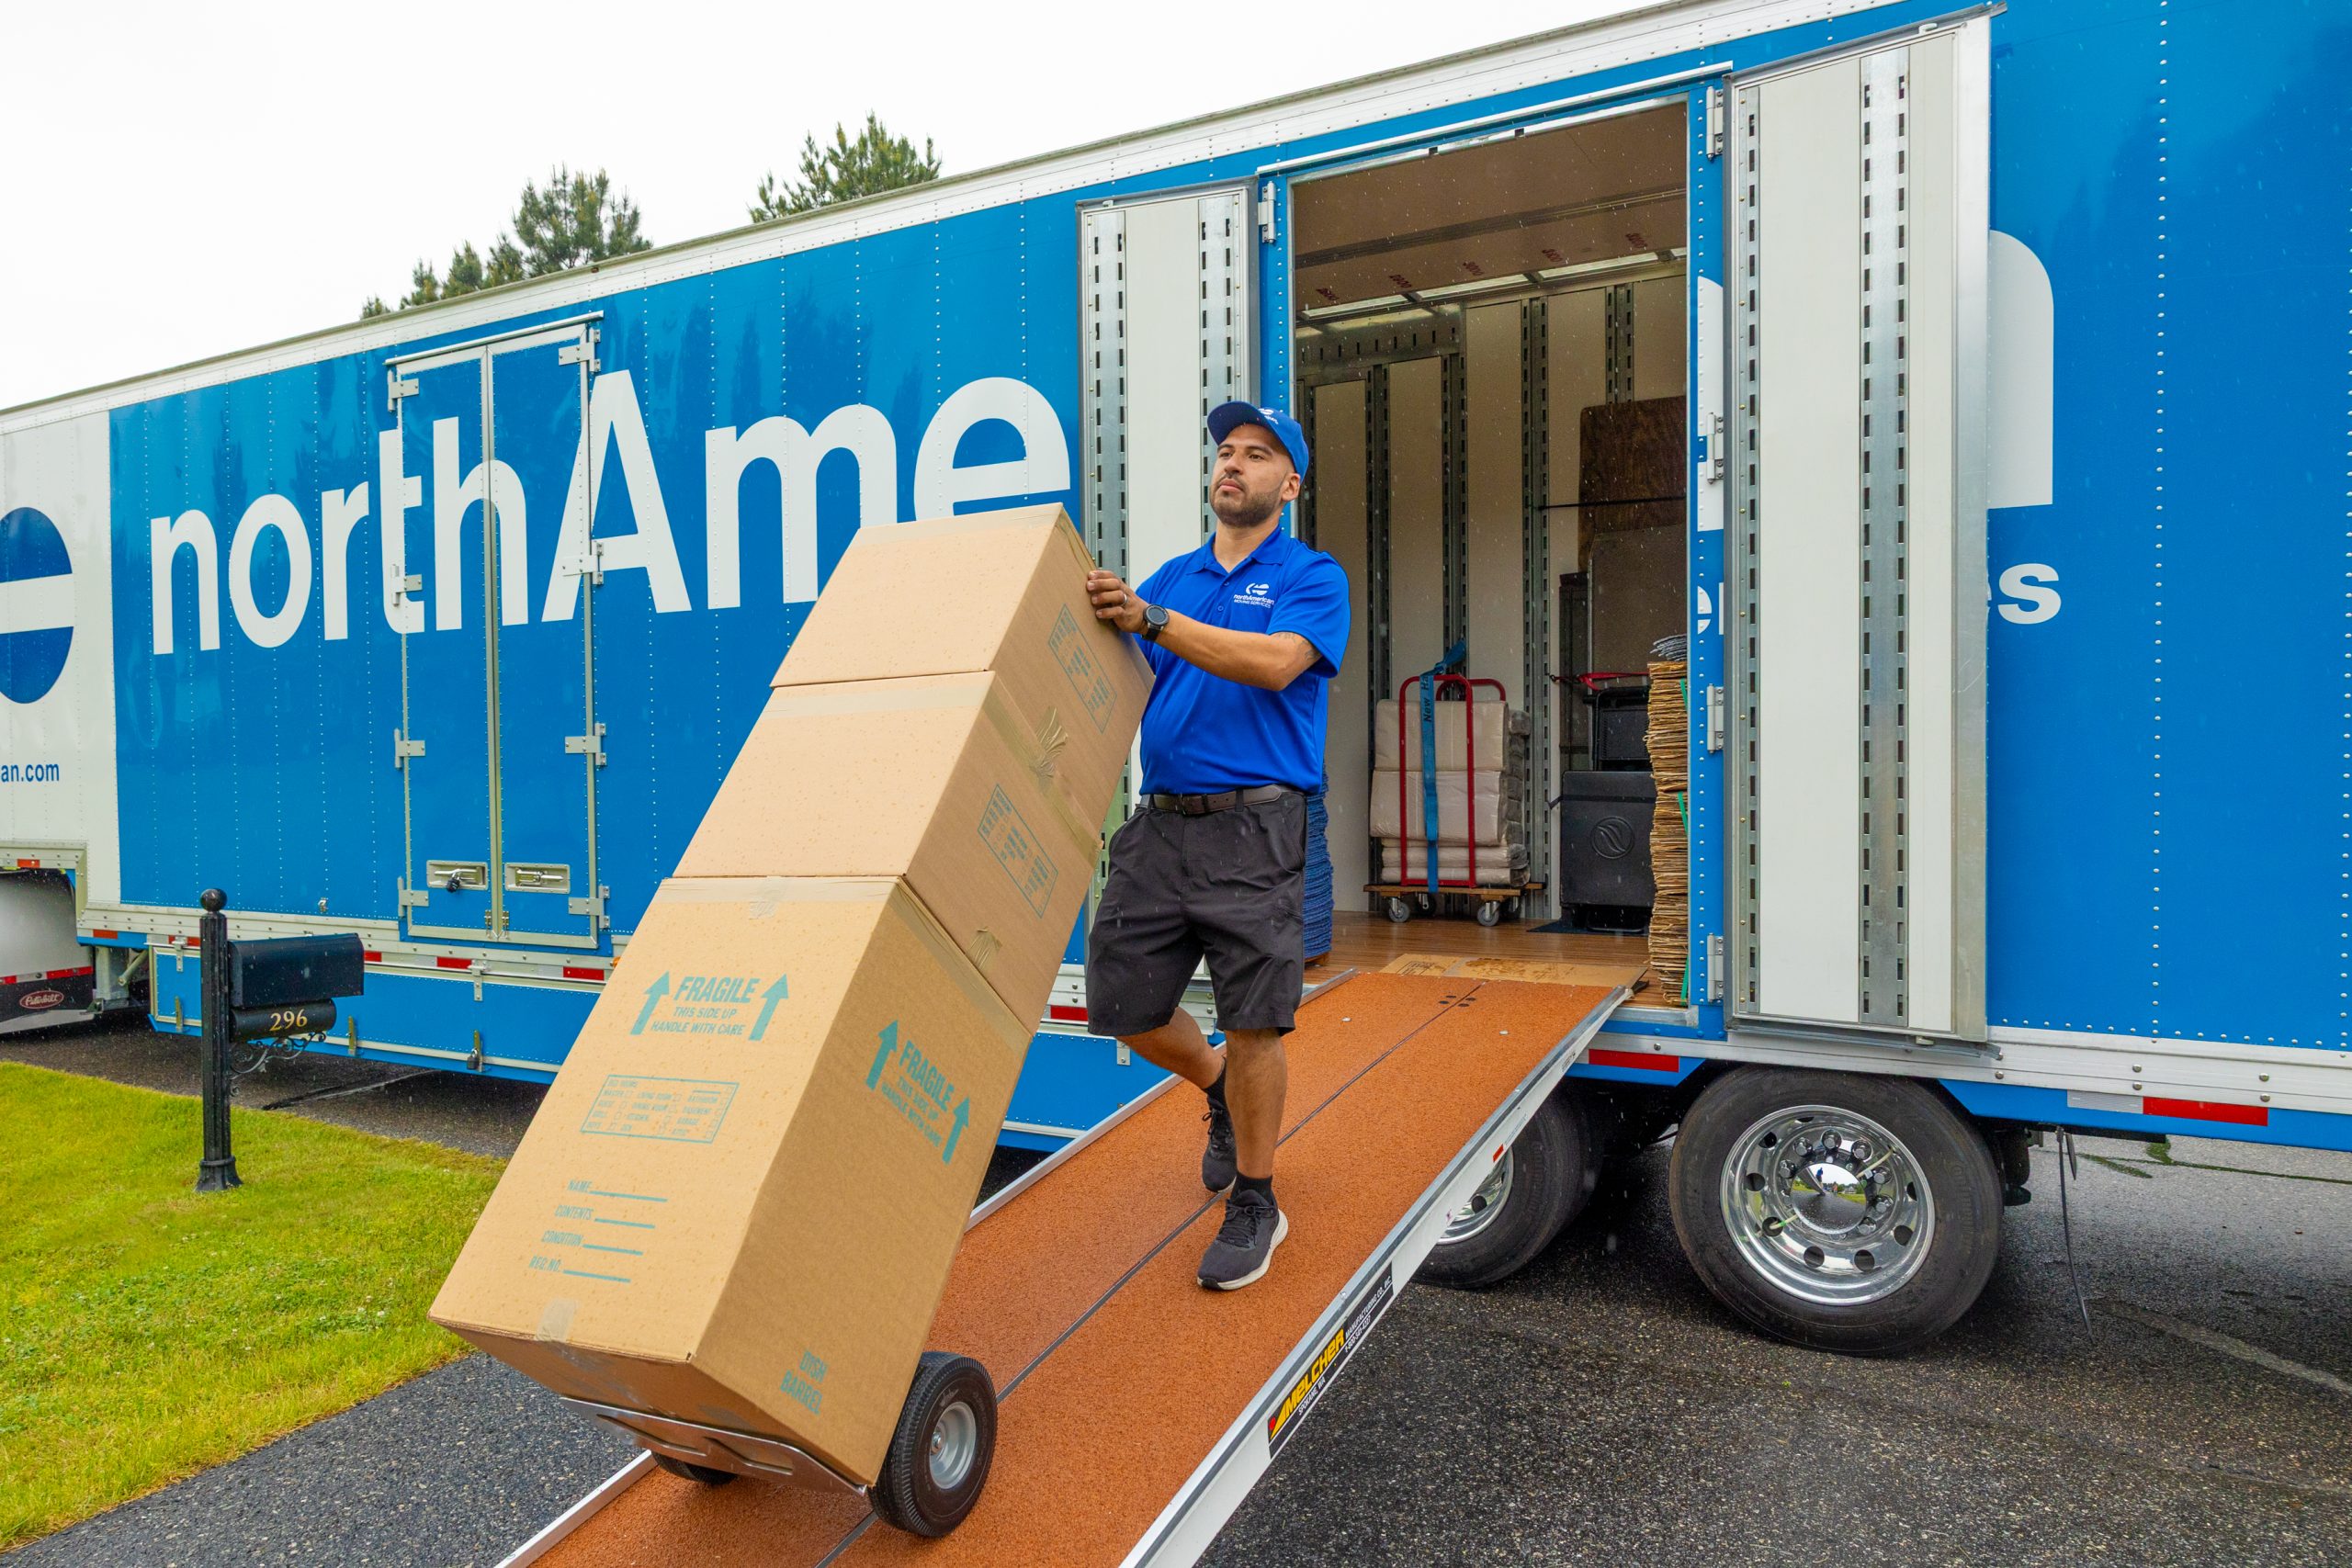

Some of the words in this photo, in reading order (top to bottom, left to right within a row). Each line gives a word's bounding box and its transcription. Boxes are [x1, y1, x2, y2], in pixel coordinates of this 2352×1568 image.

[673, 976, 761, 1004] FRAGILE
[269, 1009, 308, 1032] 296
[673, 1006, 695, 1018] THIS
[696, 1007, 719, 1020] SIDE
[721, 1009, 738, 1021] UP
[650, 1021, 689, 1033] HANDLE
[690, 1022, 715, 1034] WITH
[717, 1023, 746, 1036] CARE
[899, 1039, 956, 1112] FRAGILE
[567, 1179, 593, 1193] NAME
[554, 1204, 594, 1221] CONTENTS
[541, 1230, 584, 1247] CONDITION
[1345, 1293, 1378, 1340] MANUFACTURING
[799, 1350, 827, 1383] DISH
[779, 1369, 823, 1416] BARREL
